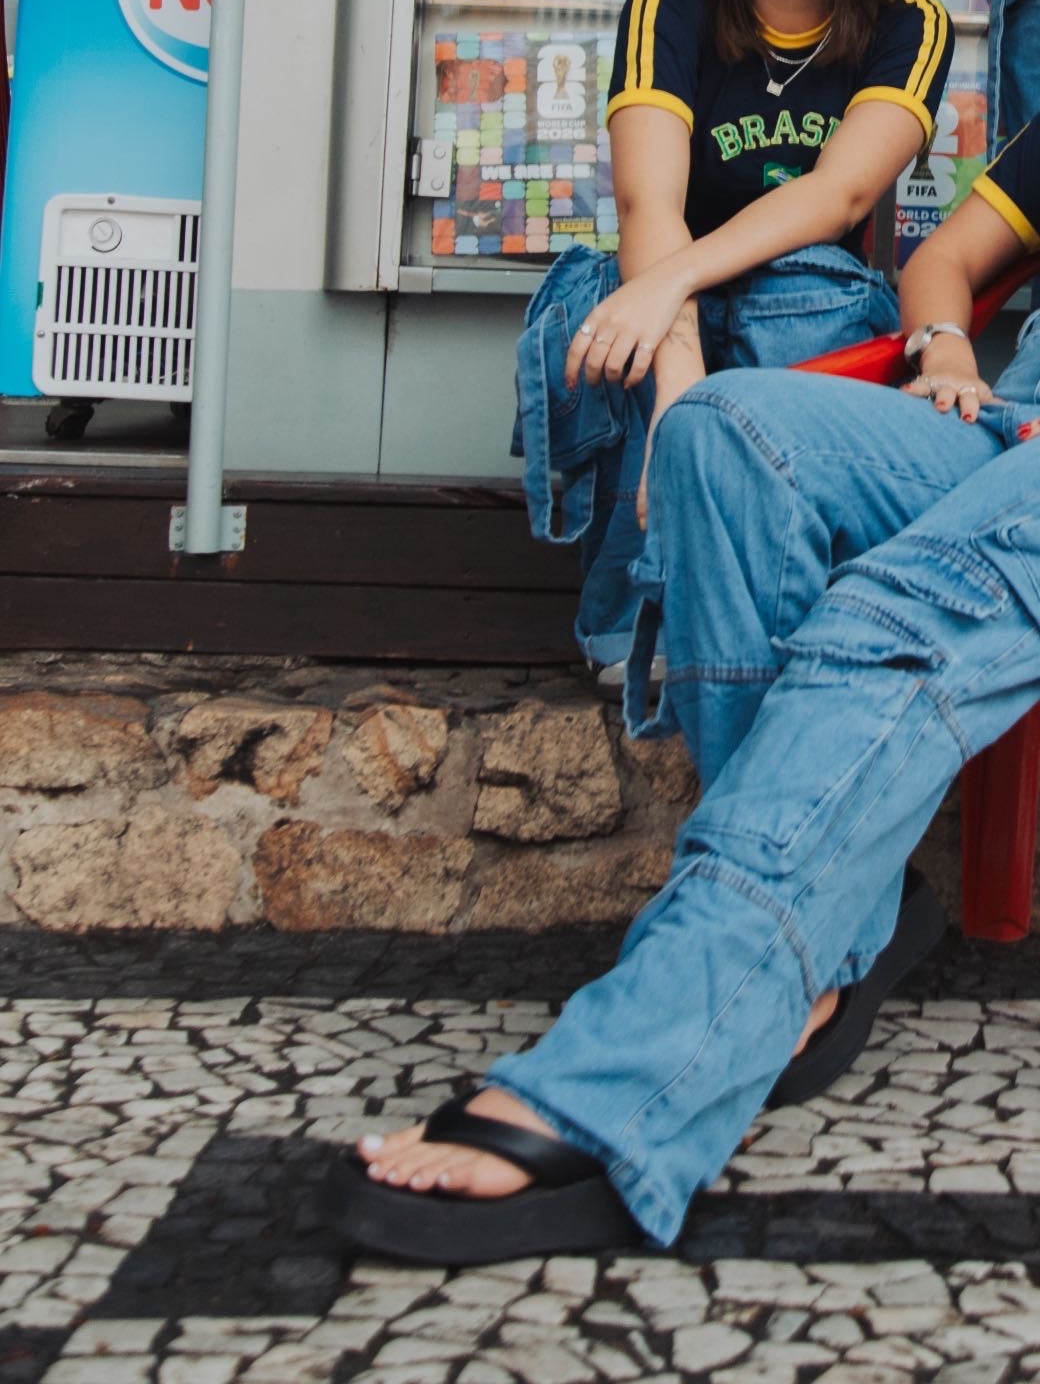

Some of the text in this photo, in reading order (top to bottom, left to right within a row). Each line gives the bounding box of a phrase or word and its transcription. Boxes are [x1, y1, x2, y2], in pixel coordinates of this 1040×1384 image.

[551, 103, 573, 112] FIFA
[537, 128, 586, 140] 2026
[711, 110, 841, 161] BRASI
[907, 185, 937, 197] FIFA
[896, 210, 929, 221] ORLD
